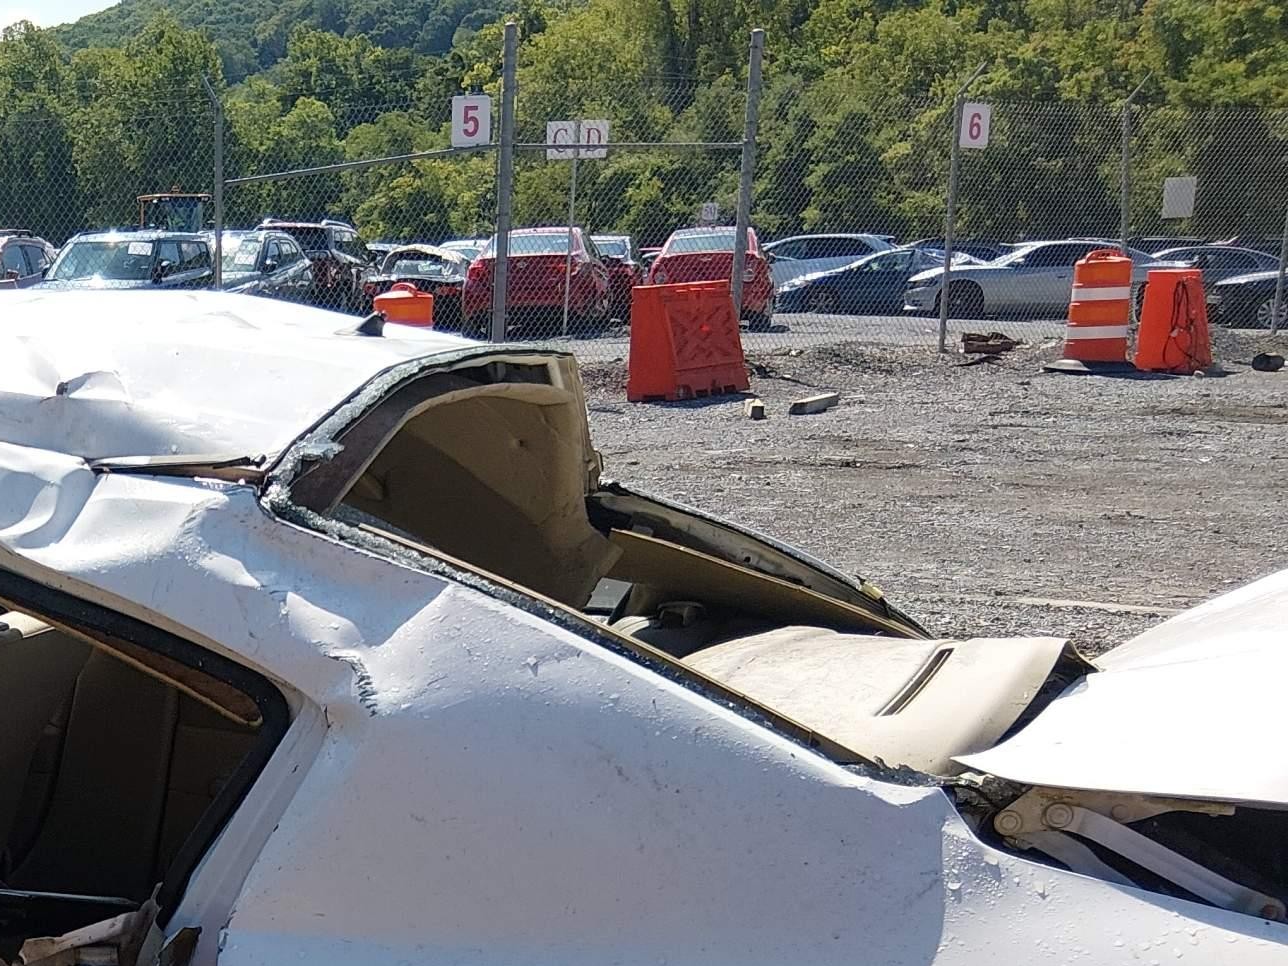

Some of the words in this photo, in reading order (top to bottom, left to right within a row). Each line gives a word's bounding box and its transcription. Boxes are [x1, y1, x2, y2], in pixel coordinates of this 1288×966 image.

[463, 105, 479, 137] 5
[968, 112, 982, 140] 6
[585, 127, 602, 152] D
